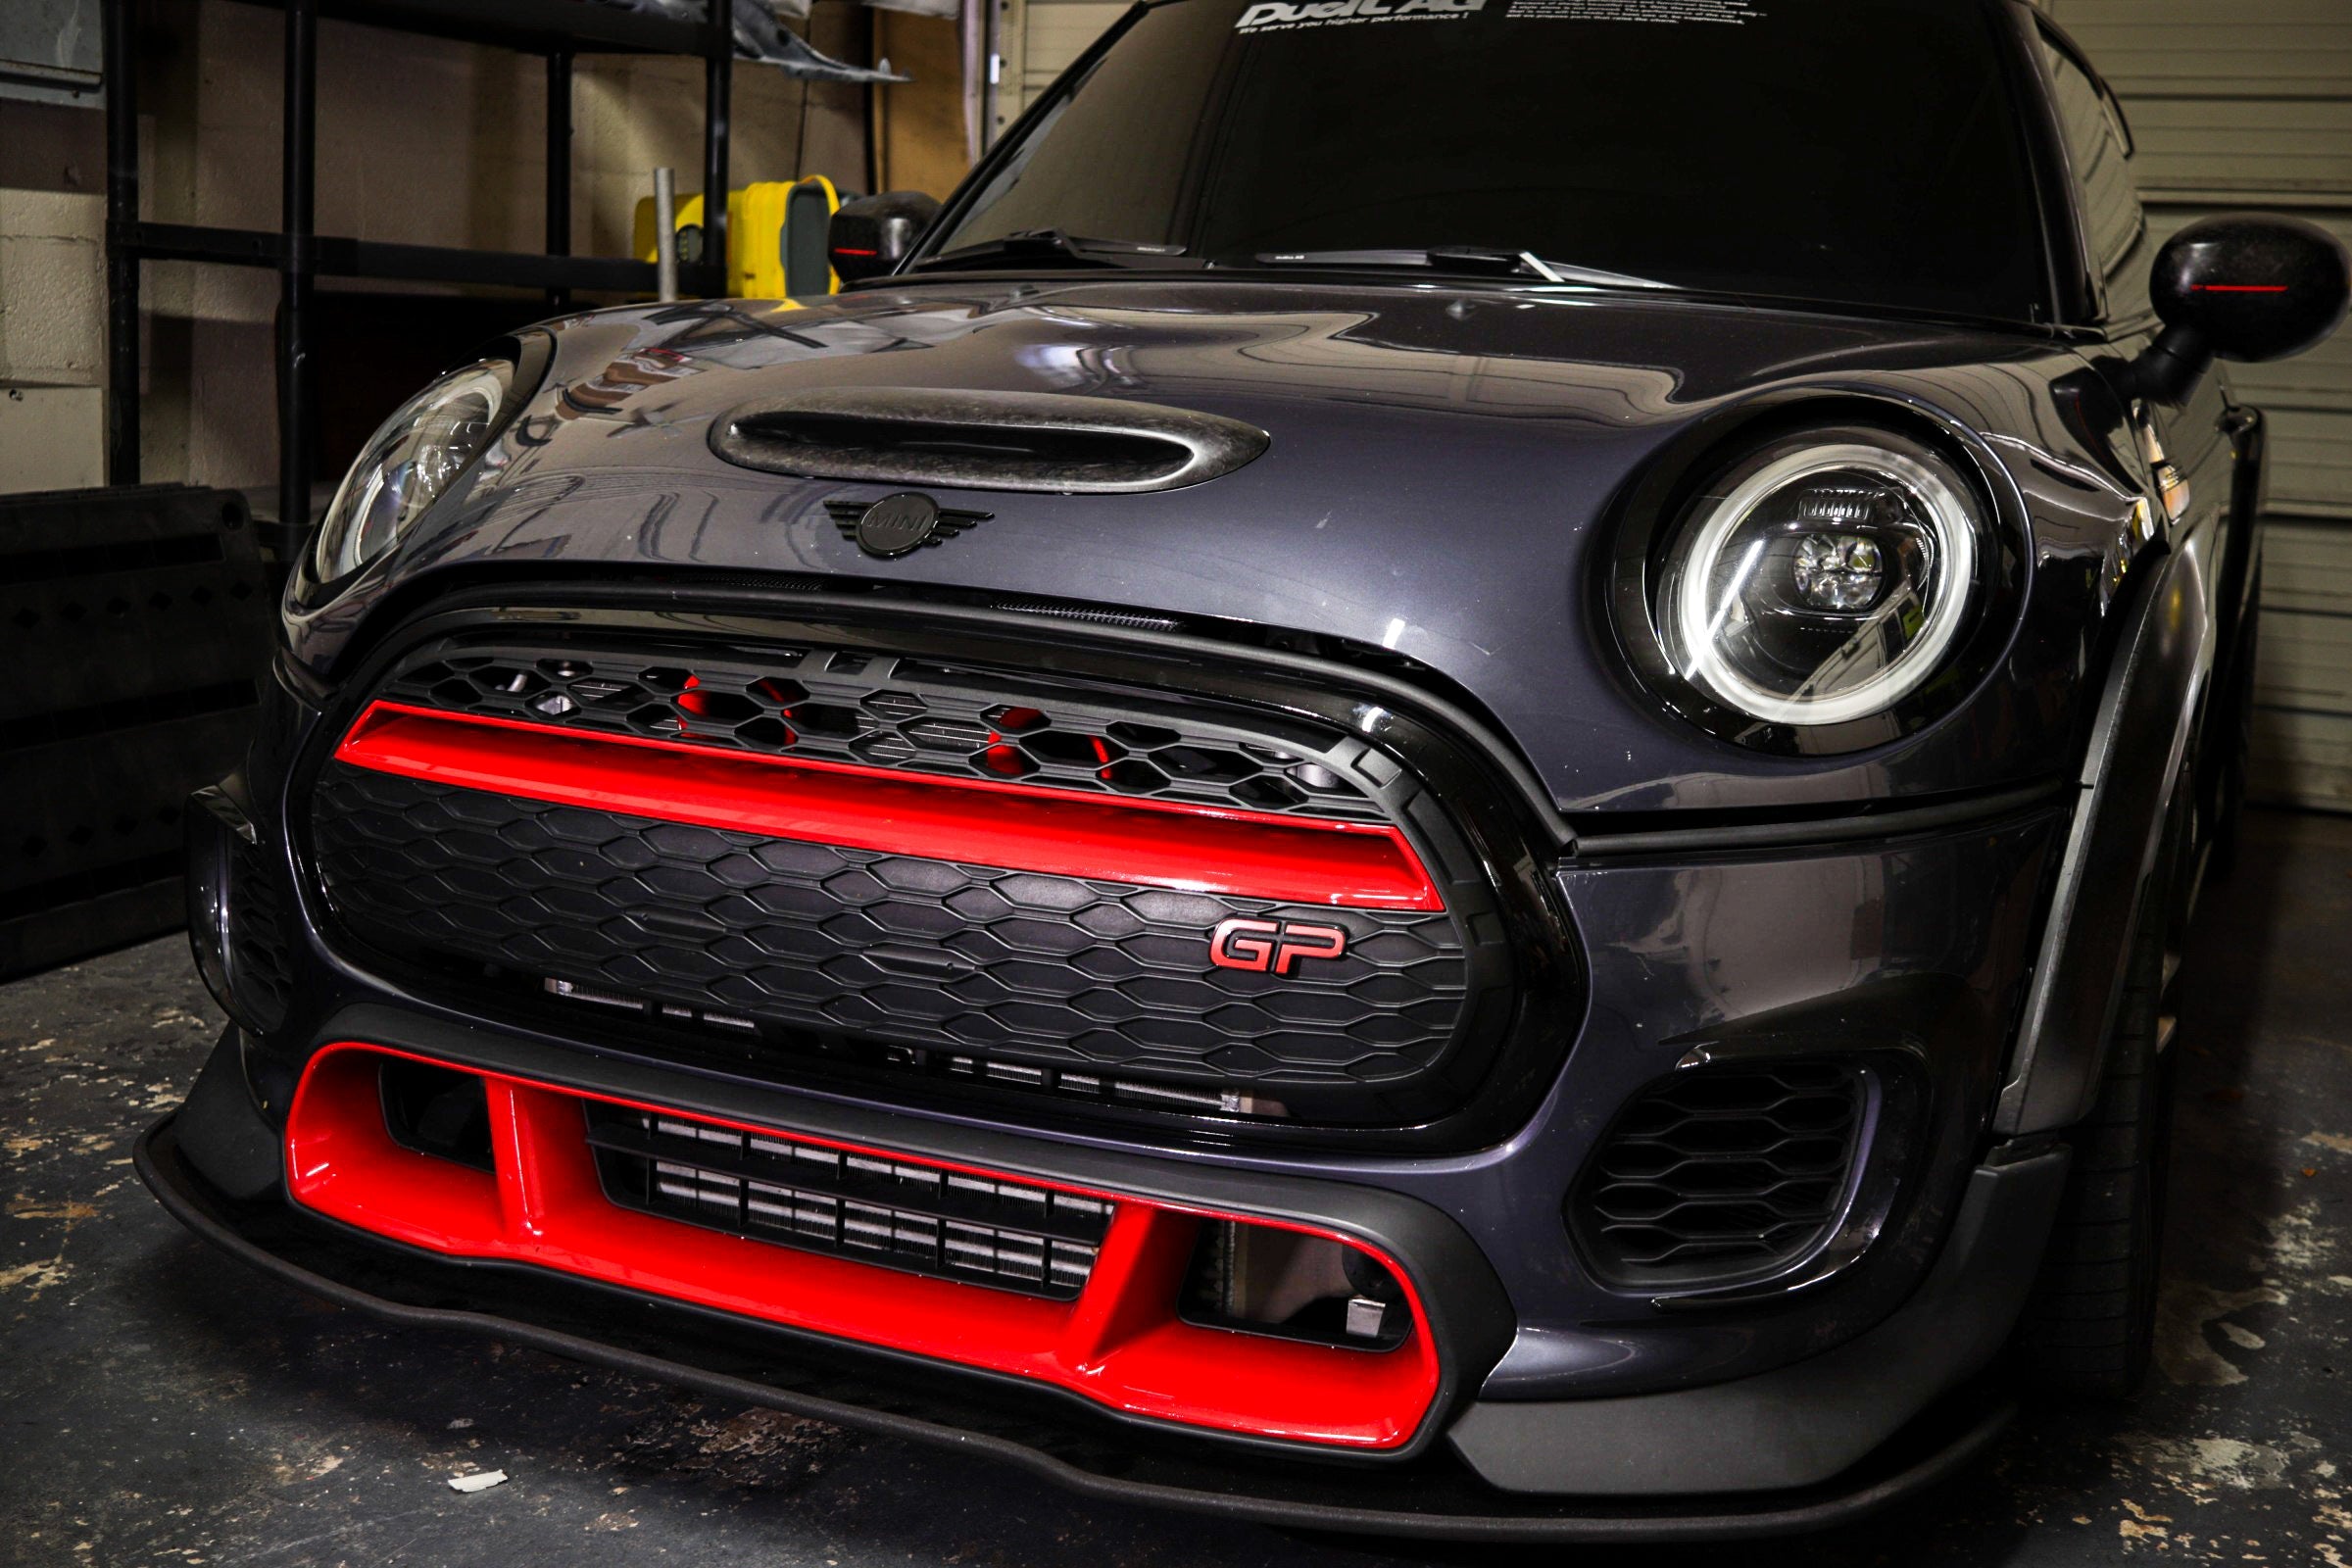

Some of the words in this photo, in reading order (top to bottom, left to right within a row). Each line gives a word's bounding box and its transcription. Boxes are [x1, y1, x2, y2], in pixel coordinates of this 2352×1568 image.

[1259, 23, 1296, 31] serve
[1296, 21, 1323, 29] you
[1324, 17, 1370, 25] higher
[867, 514, 927, 531] MINI
[1208, 916, 1348, 978] GP
